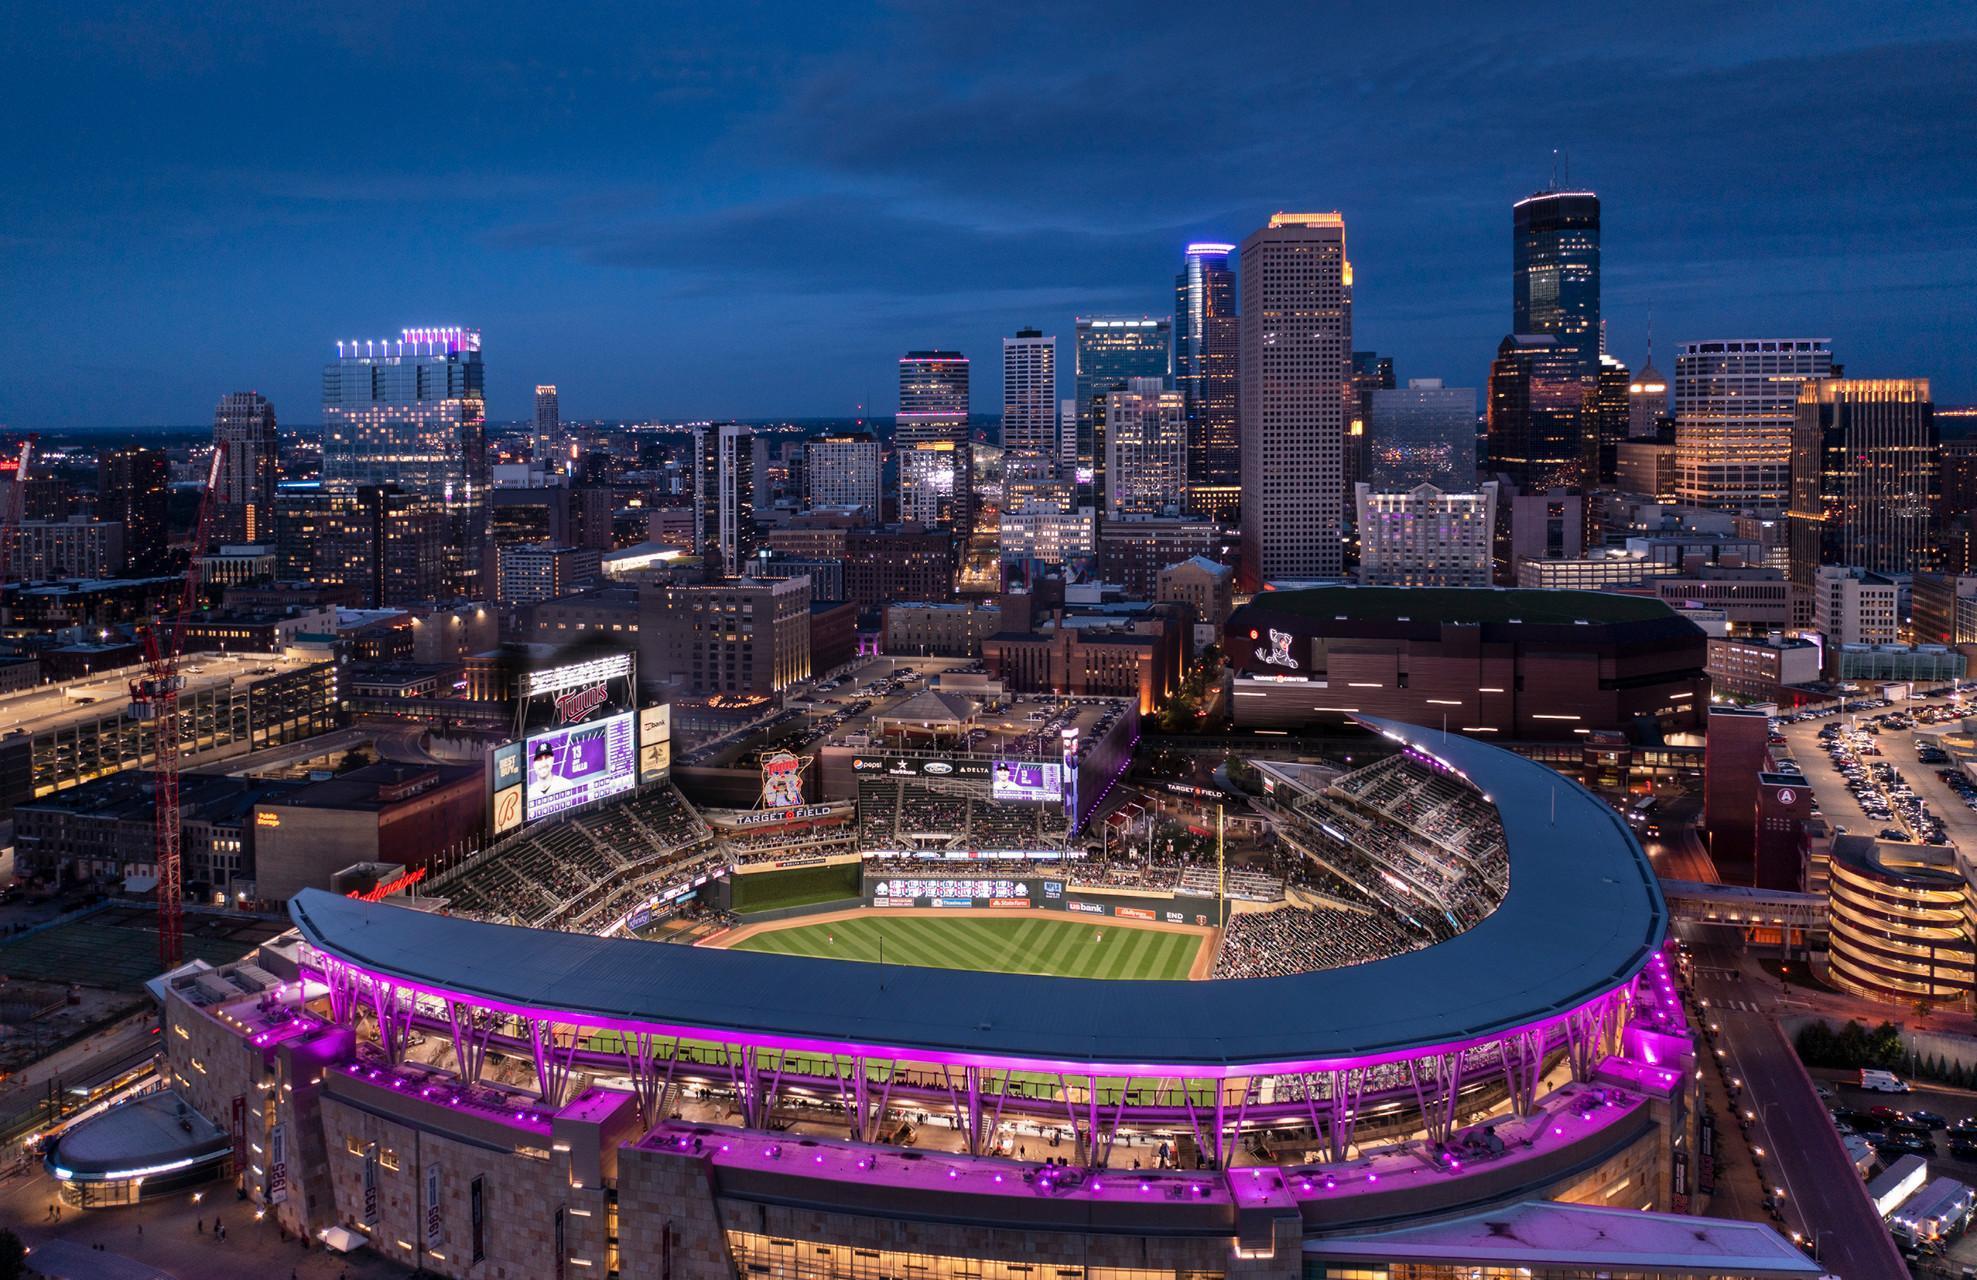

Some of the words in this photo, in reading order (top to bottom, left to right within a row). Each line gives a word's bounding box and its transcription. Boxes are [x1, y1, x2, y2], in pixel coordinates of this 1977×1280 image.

[555, 683, 607, 724] Twins
[572, 745, 581, 759] 13
[499, 755, 516, 768] BEST
[1168, 784, 1194, 793] TARGET
[1781, 790, 1792, 800] A
[737, 812, 785, 825] TARGET
[796, 807, 831, 817] FIELD
[1166, 911, 1184, 919] END
[272, 1163, 285, 1193] 1925
[365, 1187, 376, 1218] 1933
